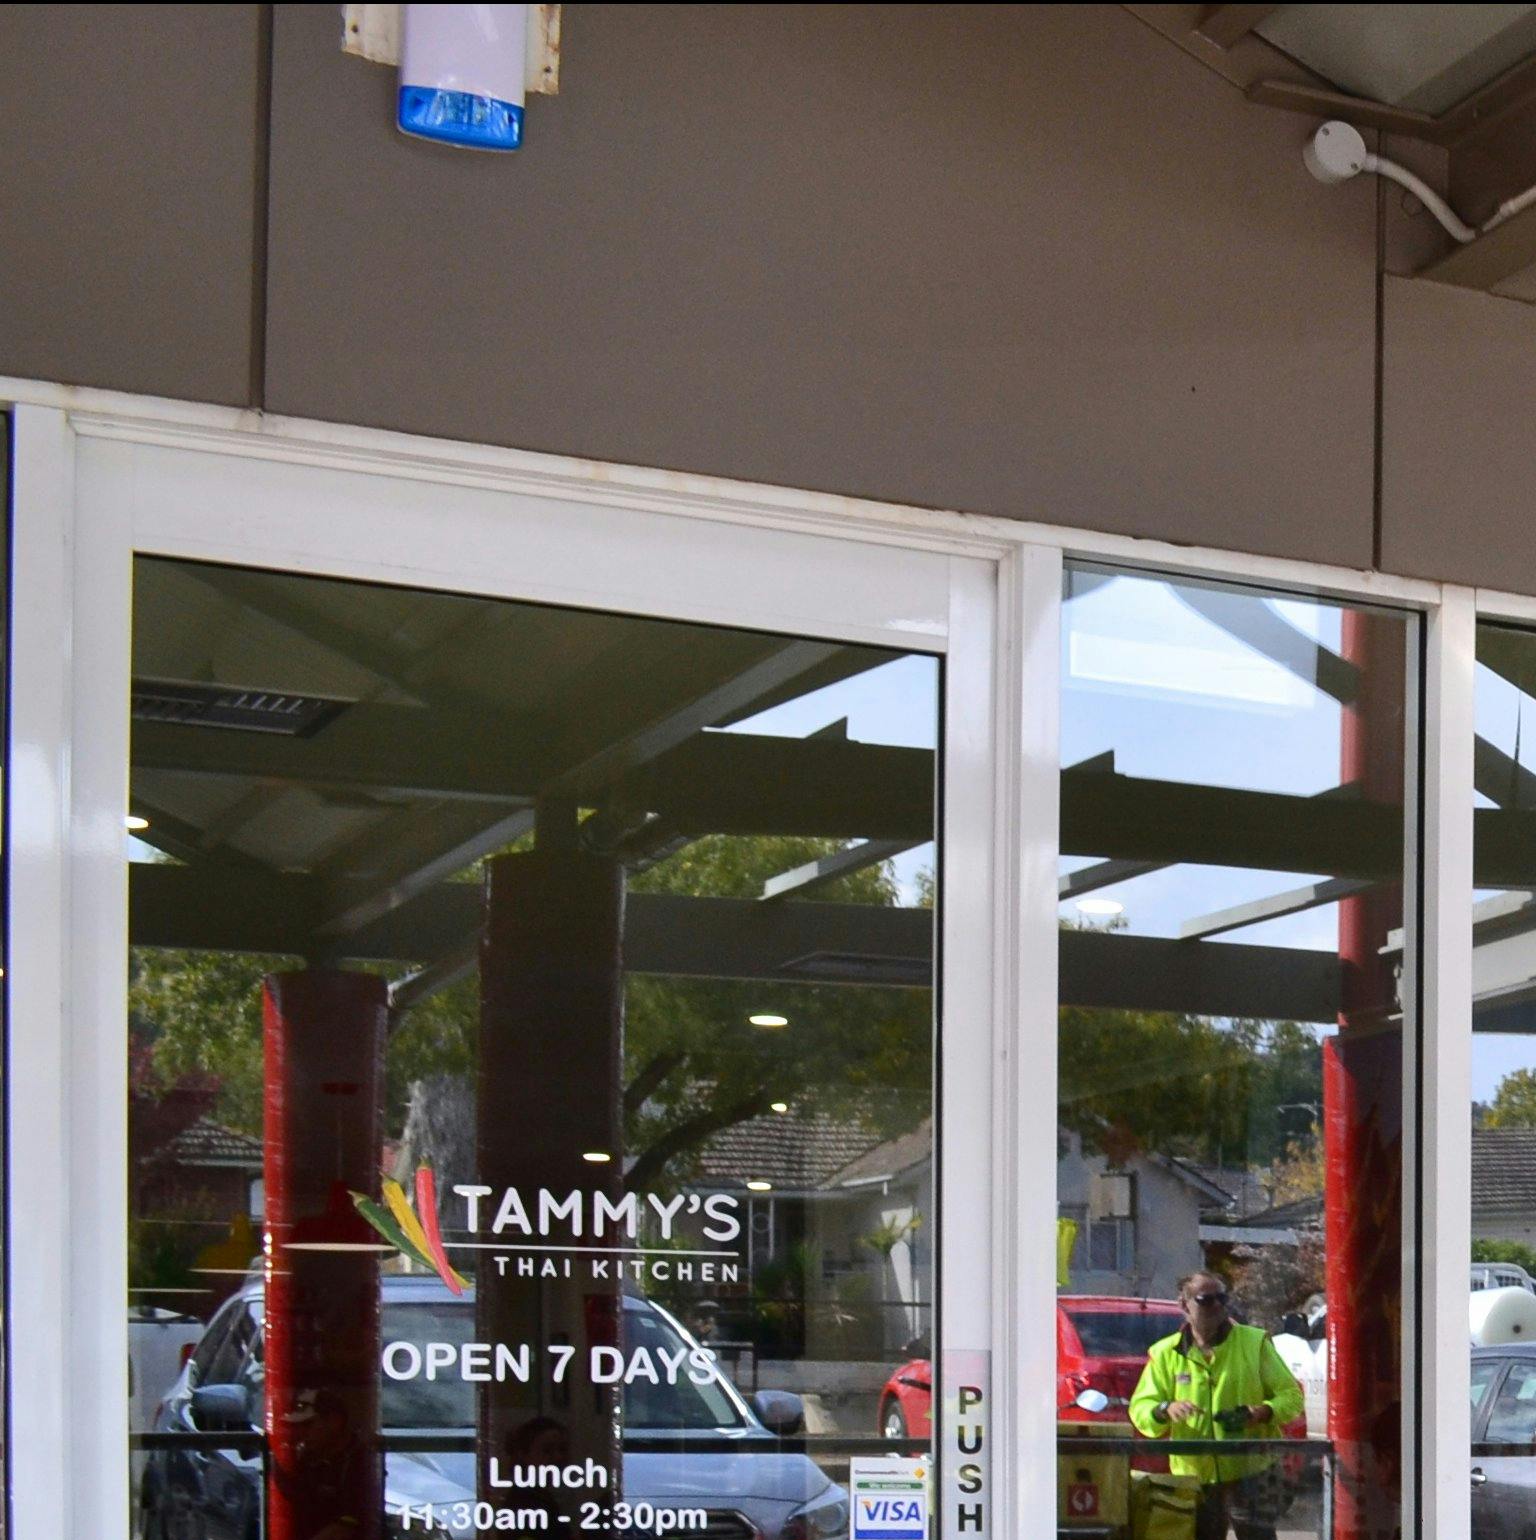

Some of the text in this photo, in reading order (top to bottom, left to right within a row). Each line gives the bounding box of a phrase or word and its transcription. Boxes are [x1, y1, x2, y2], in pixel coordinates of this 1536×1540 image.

[452, 1184, 741, 1243] TAMMY'S
[494, 1256, 740, 1282] THAI KITCHEN
[381, 1341, 718, 1386] OPEN 7 DAYS
[489, 1457, 608, 1489] Lunch
[957, 1385, 983, 1533] PUSH
[400, 1501, 549, 1531] 11:30am
[580, 1501, 708, 1537] 2:30pm
[861, 1500, 921, 1522] VISA
